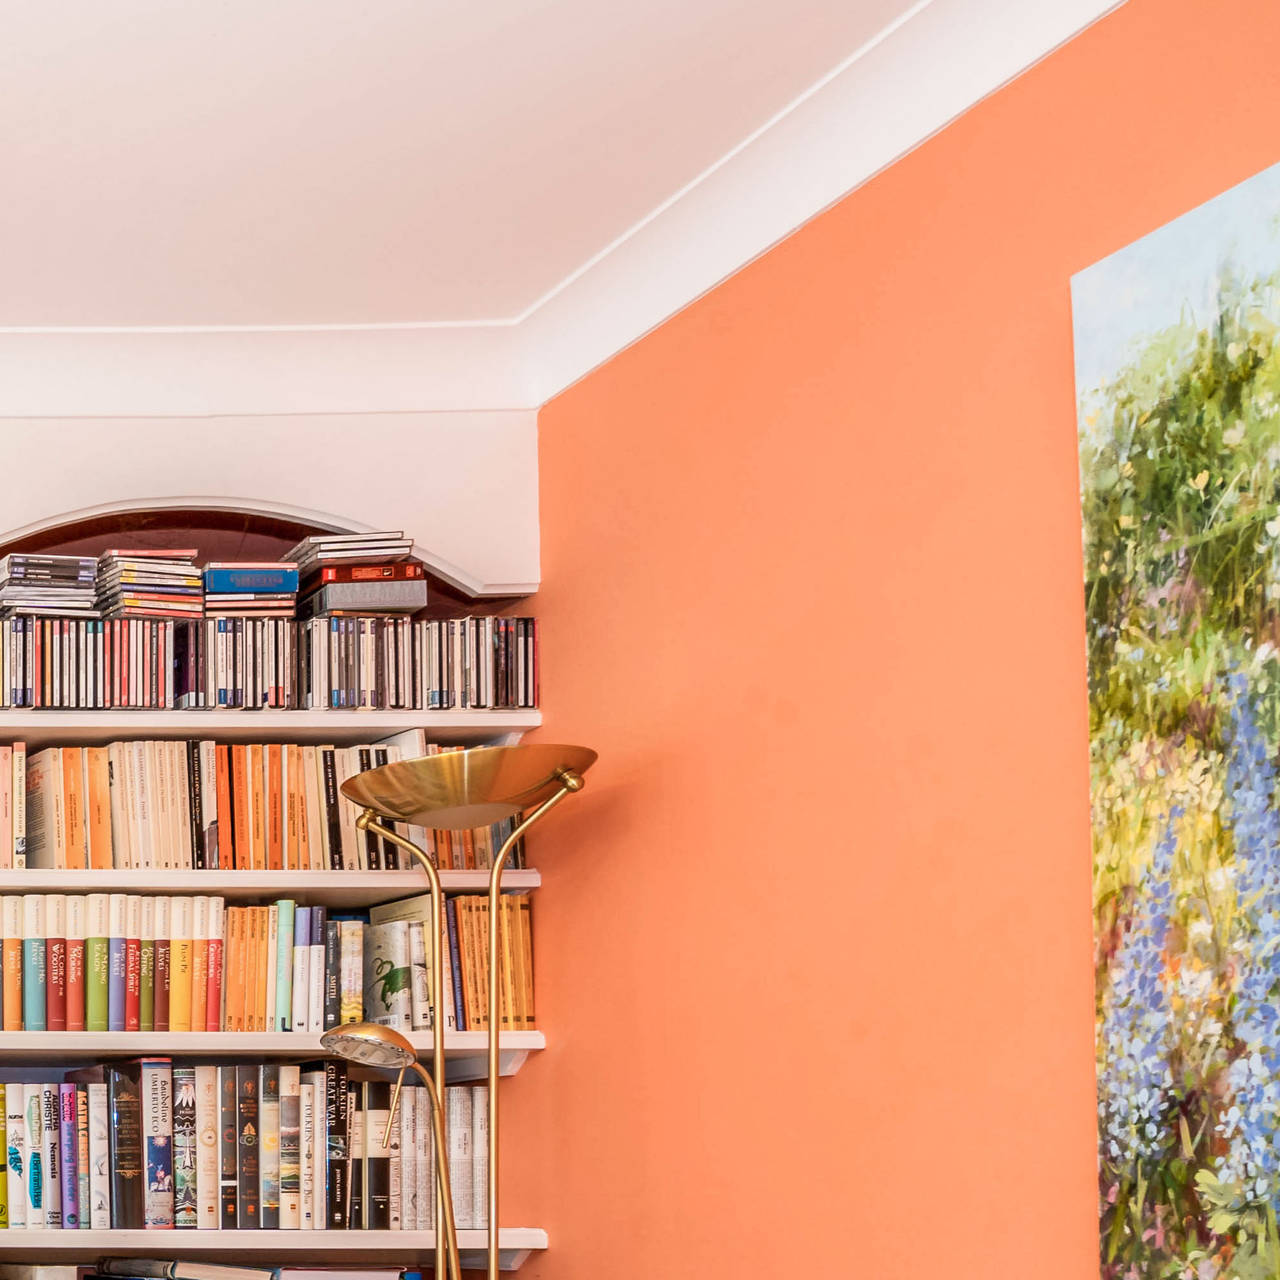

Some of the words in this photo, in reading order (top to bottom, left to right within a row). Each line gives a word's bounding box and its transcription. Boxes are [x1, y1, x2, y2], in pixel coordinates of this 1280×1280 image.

[151, 1074, 159, 1113] UMBERTO
[161, 1080, 169, 1123] Baudolino
[328, 1066, 336, 1102] GREAT
[44, 1090, 52, 1131] CHRISTIE
[328, 1104, 336, 1126] WAR
